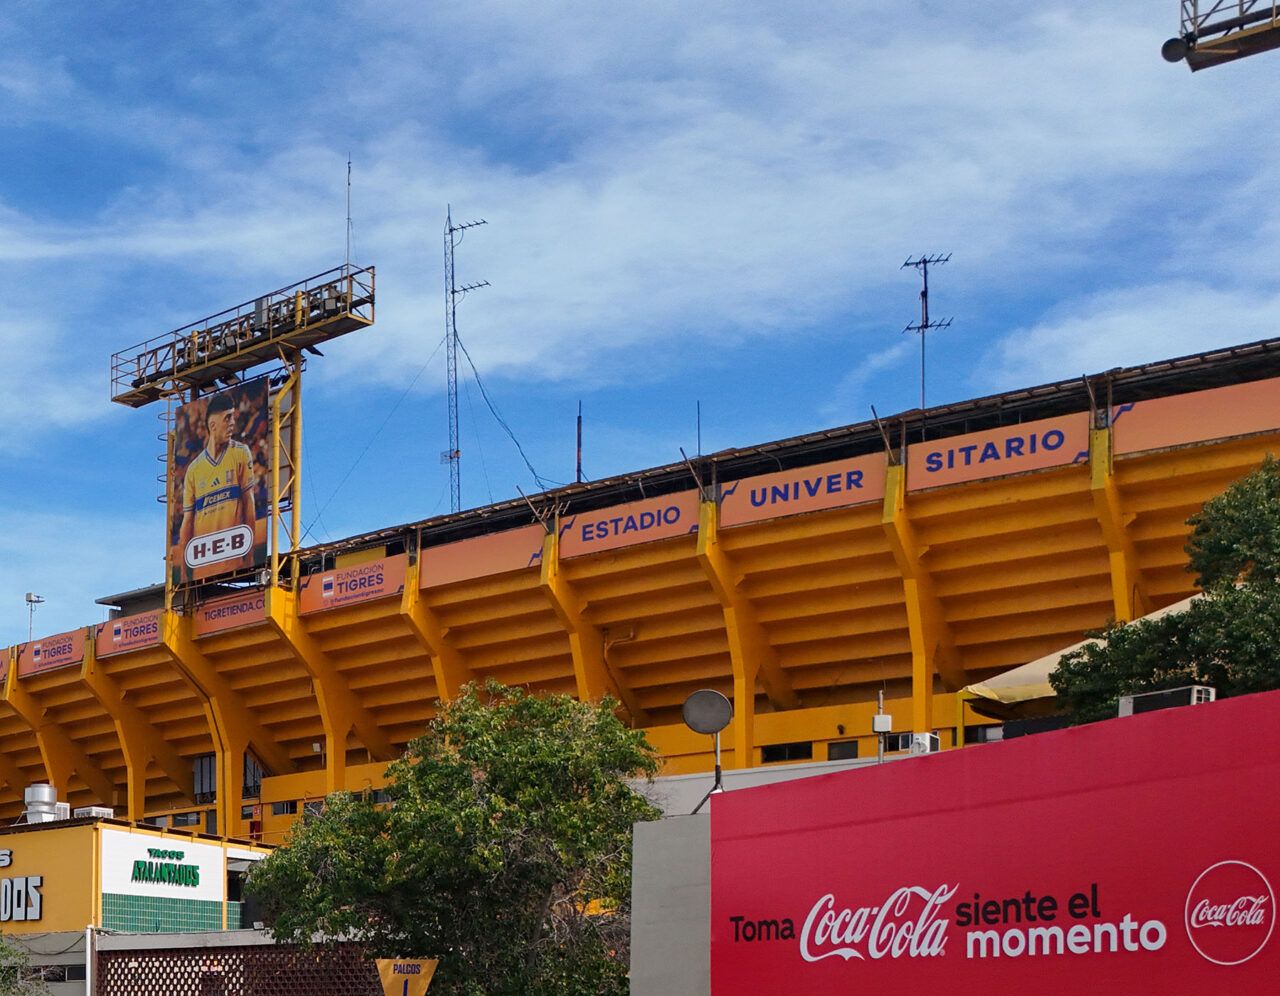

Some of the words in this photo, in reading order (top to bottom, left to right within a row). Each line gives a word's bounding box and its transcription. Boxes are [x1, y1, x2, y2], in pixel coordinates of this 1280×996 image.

[925, 429, 1065, 473] SITARIO
[750, 470, 864, 507] UNIVER
[581, 505, 681, 542] ESTADIO
[337, 573, 384, 594] TIGRES
[204, 599, 265, 622] TIGRETIENDA.C
[123, 622, 158, 639] TIGRES
[42, 643, 73, 659] TIGRES
[147, 848, 185, 861] TACOS
[730, 914, 796, 944] Toma
[799, 882, 960, 962] Coca-Cola
[956, 892, 1058, 928] siente
[1067, 883, 1101, 919] el
[1190, 894, 1269, 929] Coca-Cola
[966, 912, 1168, 959] momento
[393, 963, 421, 975] PALCOS
